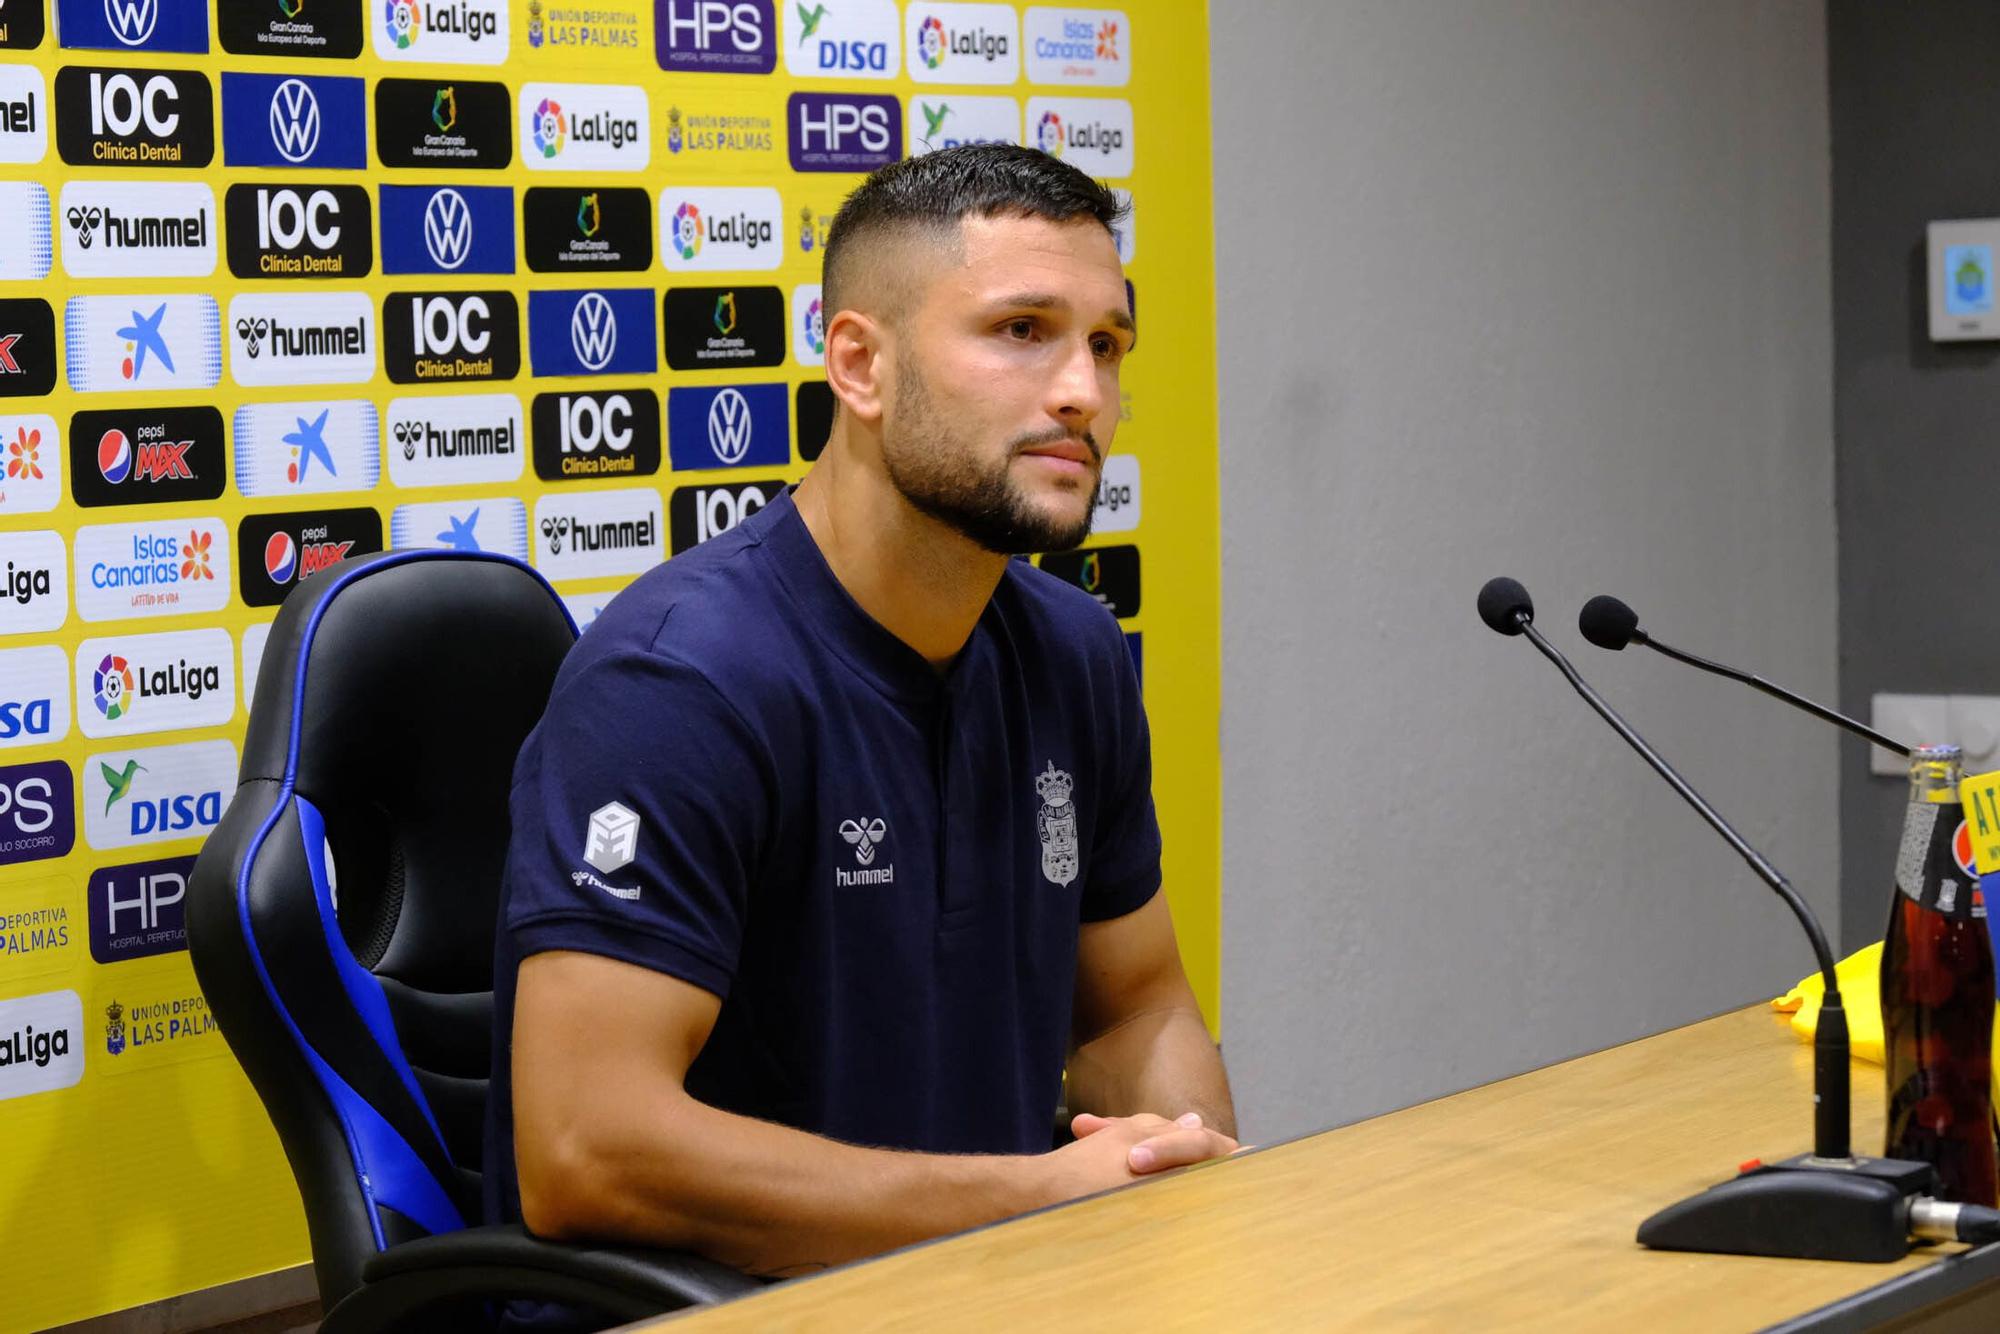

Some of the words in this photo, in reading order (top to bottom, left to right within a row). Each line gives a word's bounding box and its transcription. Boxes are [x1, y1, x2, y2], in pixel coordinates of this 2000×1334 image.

[426, 3, 497, 42] LaLiga
[549, 26, 577, 46] LAS
[580, 27, 639, 48] PALMAS
[668, 0, 762, 52] HPS
[951, 28, 1008, 61] LaLiga
[89, 73, 179, 138] IOC
[571, 111, 638, 149] LaLiga
[687, 131, 714, 150] LAS
[717, 132, 772, 151] PALMAS
[800, 103, 890, 152] HPS
[1068, 123, 1123, 155] LaLiga
[93, 141, 138, 161] Clínica
[140, 143, 181, 161] Dental
[105, 208, 207, 248] hummel
[257, 189, 341, 250] IOC
[708, 212, 771, 249] LaLiga
[260, 254, 302, 272] Clínica
[303, 255, 343, 273] Dental
[271, 316, 366, 356] hummel
[412, 296, 490, 355] IOC
[415, 359, 455, 377] Clínica
[456, 358, 493, 376] Dental
[137, 424, 165, 441] pepsi
[426, 417, 515, 459] hummel
[559, 394, 634, 453] IOC
[134, 440, 195, 483] MAX
[600, 455, 635, 472] Dental
[133, 533, 178, 560] Islas
[301, 525, 328, 542] pepsi
[571, 511, 655, 551] hummel
[0, 561, 50, 605] iga
[91, 558, 179, 589] Canarias
[139, 659, 219, 700] LaLiga
[14, 836, 55, 850] SOCORRO
[587, 873, 641, 900] hummel
[836, 864, 893, 887] hummel
[107, 873, 191, 935] HP
[0, 1025, 69, 1068] aLiga
[132, 1022, 165, 1046] LAS
[170, 1013, 217, 1040] PALM
